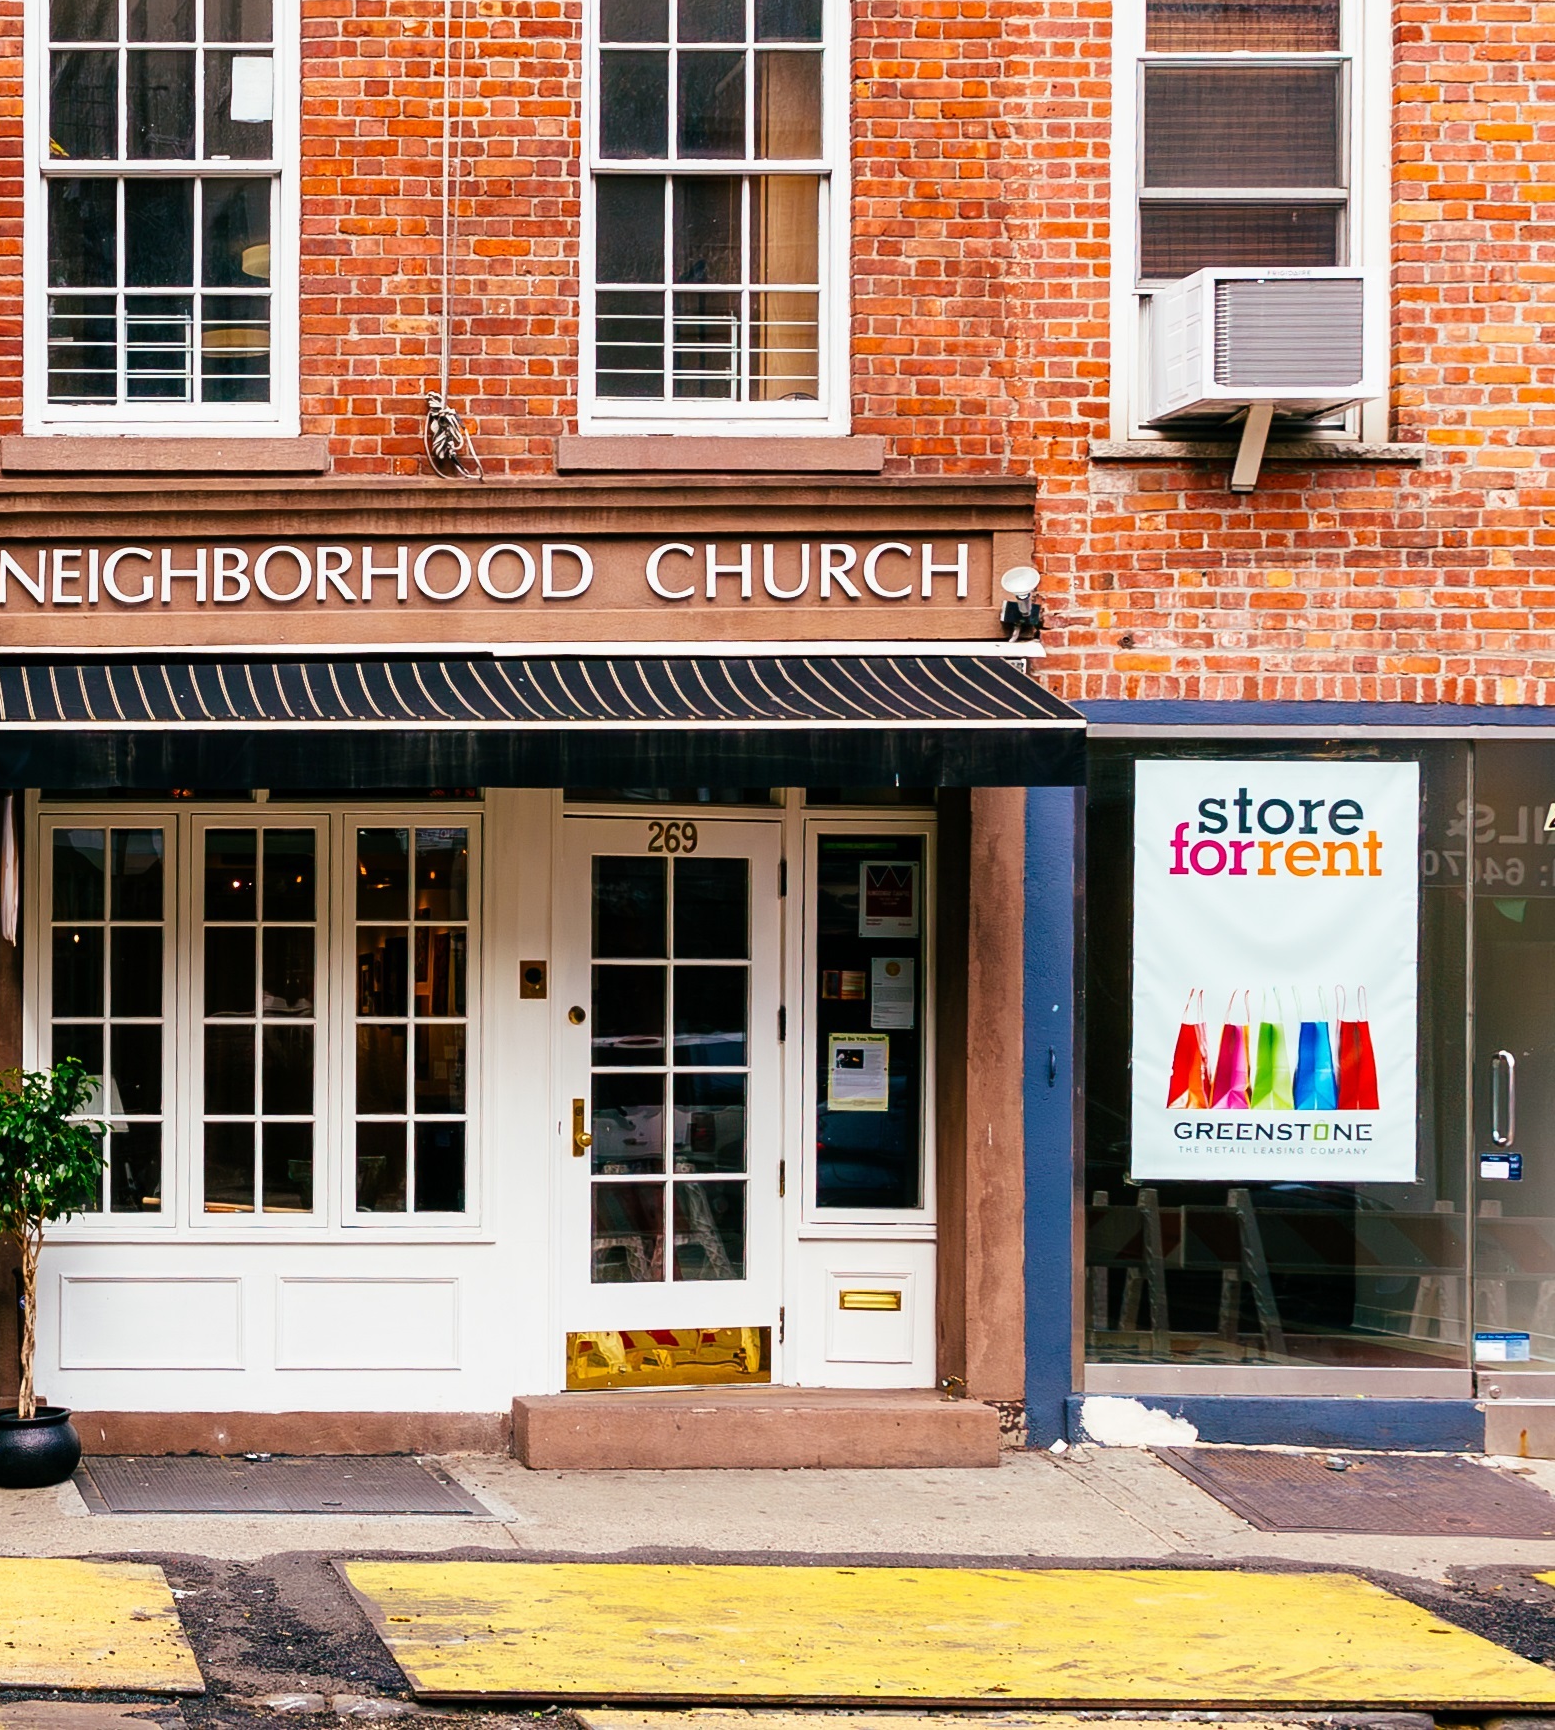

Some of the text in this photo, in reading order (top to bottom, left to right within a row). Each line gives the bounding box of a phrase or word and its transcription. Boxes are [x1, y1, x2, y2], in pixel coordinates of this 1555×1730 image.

[645, 542, 969, 600] CHURCH
[1197, 787, 1364, 836] store
[648, 821, 698, 854] 269
[1173, 1121, 1373, 1141] GREENSTONE
[1179, 1145, 1368, 1155] THE RETAIL LEASING COMPANY
